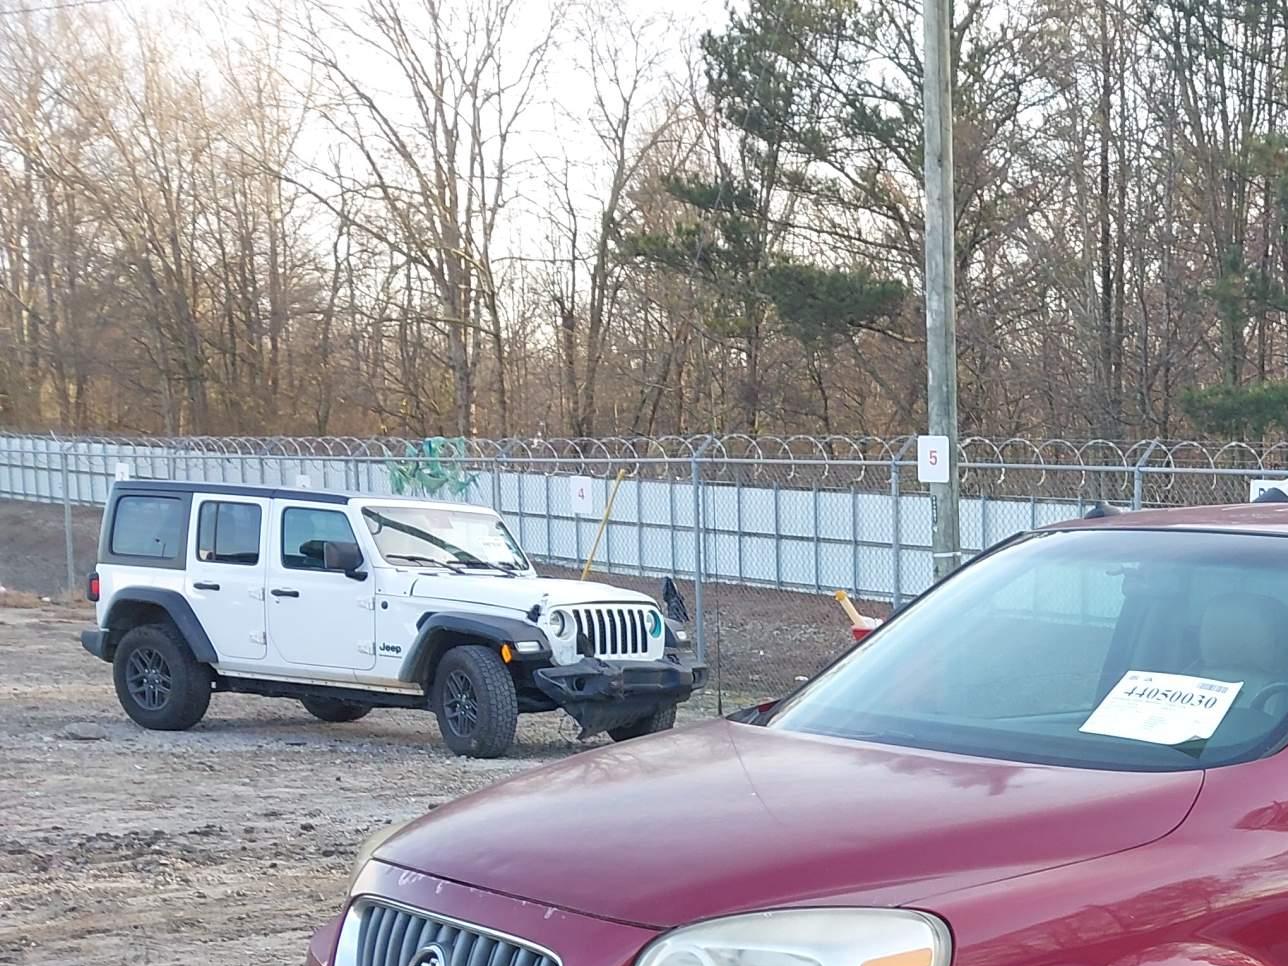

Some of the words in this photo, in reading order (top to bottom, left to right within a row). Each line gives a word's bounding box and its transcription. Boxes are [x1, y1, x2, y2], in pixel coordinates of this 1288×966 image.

[929, 450, 938, 466] 5
[577, 487, 585, 500] 4
[379, 642, 402, 654] Jeep
[1123, 686, 1218, 709] 44050030
